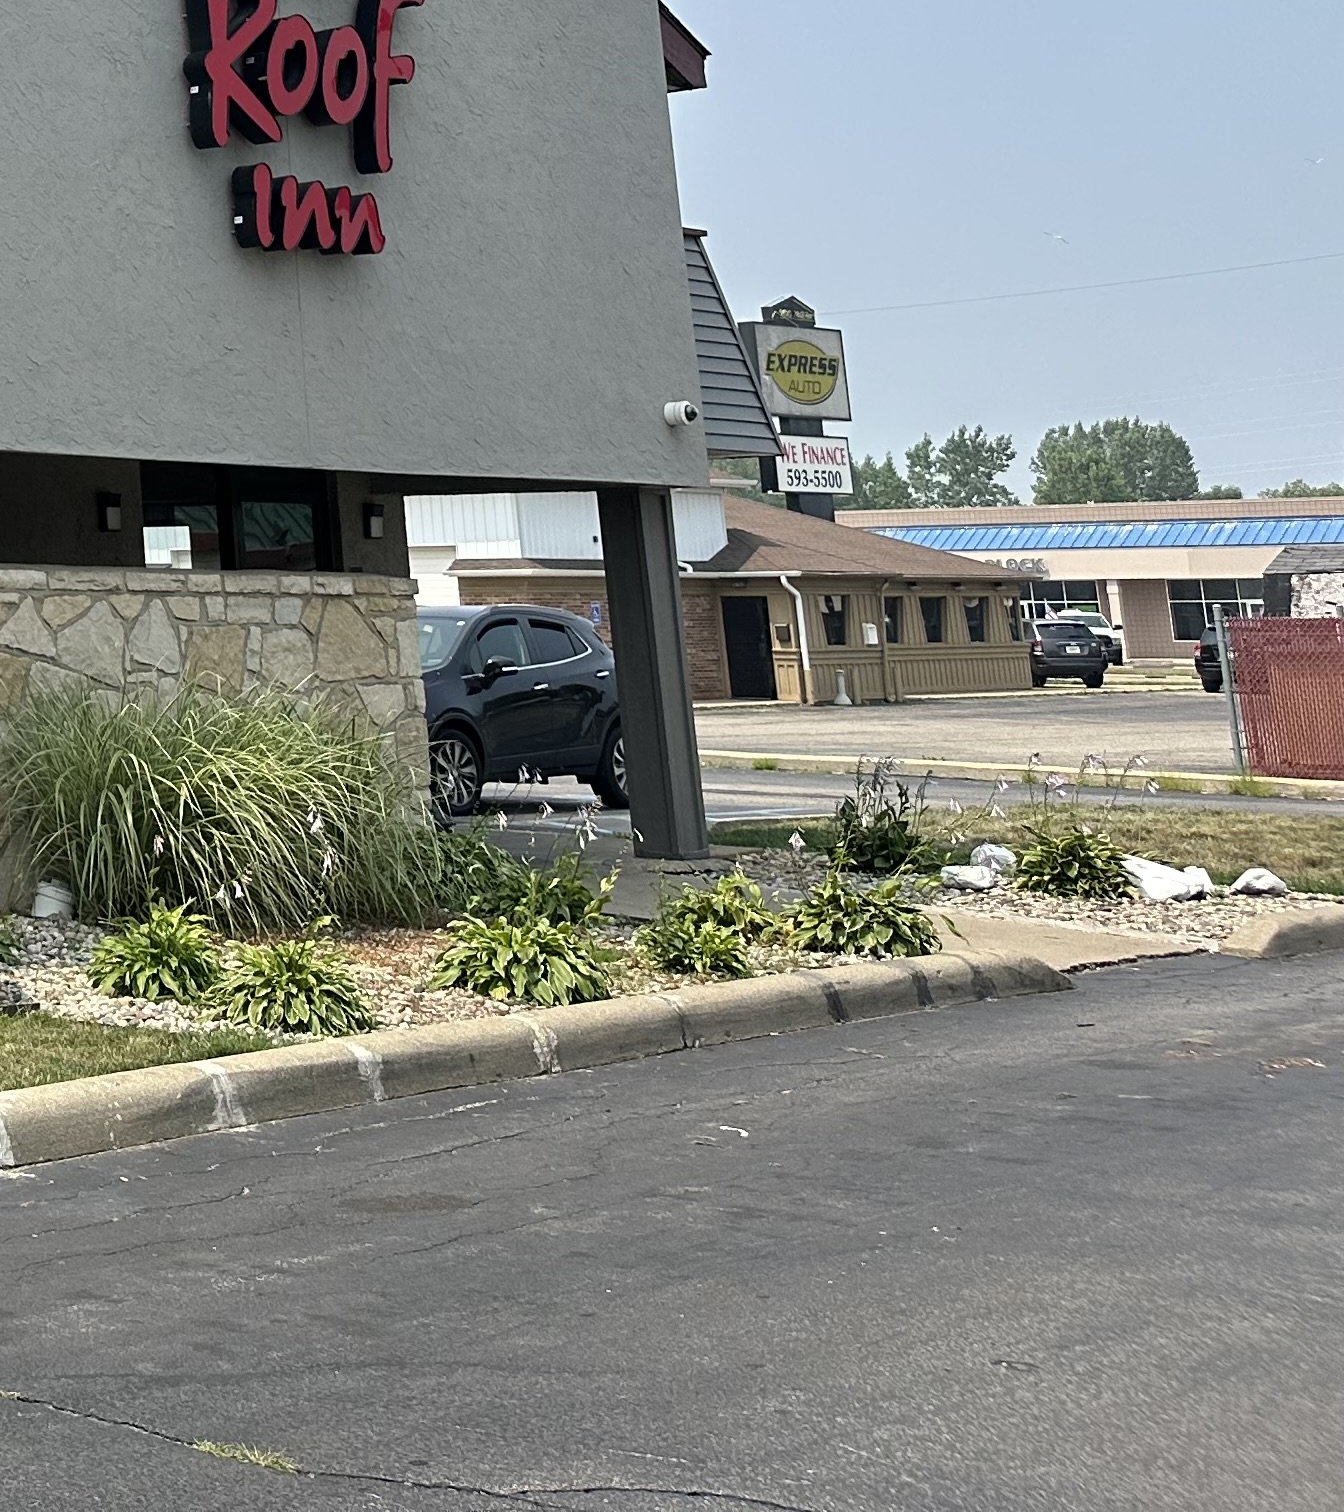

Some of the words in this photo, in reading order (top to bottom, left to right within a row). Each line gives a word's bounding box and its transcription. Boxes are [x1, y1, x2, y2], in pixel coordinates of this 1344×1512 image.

[766, 352, 839, 377] EXPRESS
[788, 379, 822, 395] AUTO
[781, 442, 798, 464] WE
[801, 442, 847, 467] FINANCE
[787, 468, 843, 489] 593-5500
